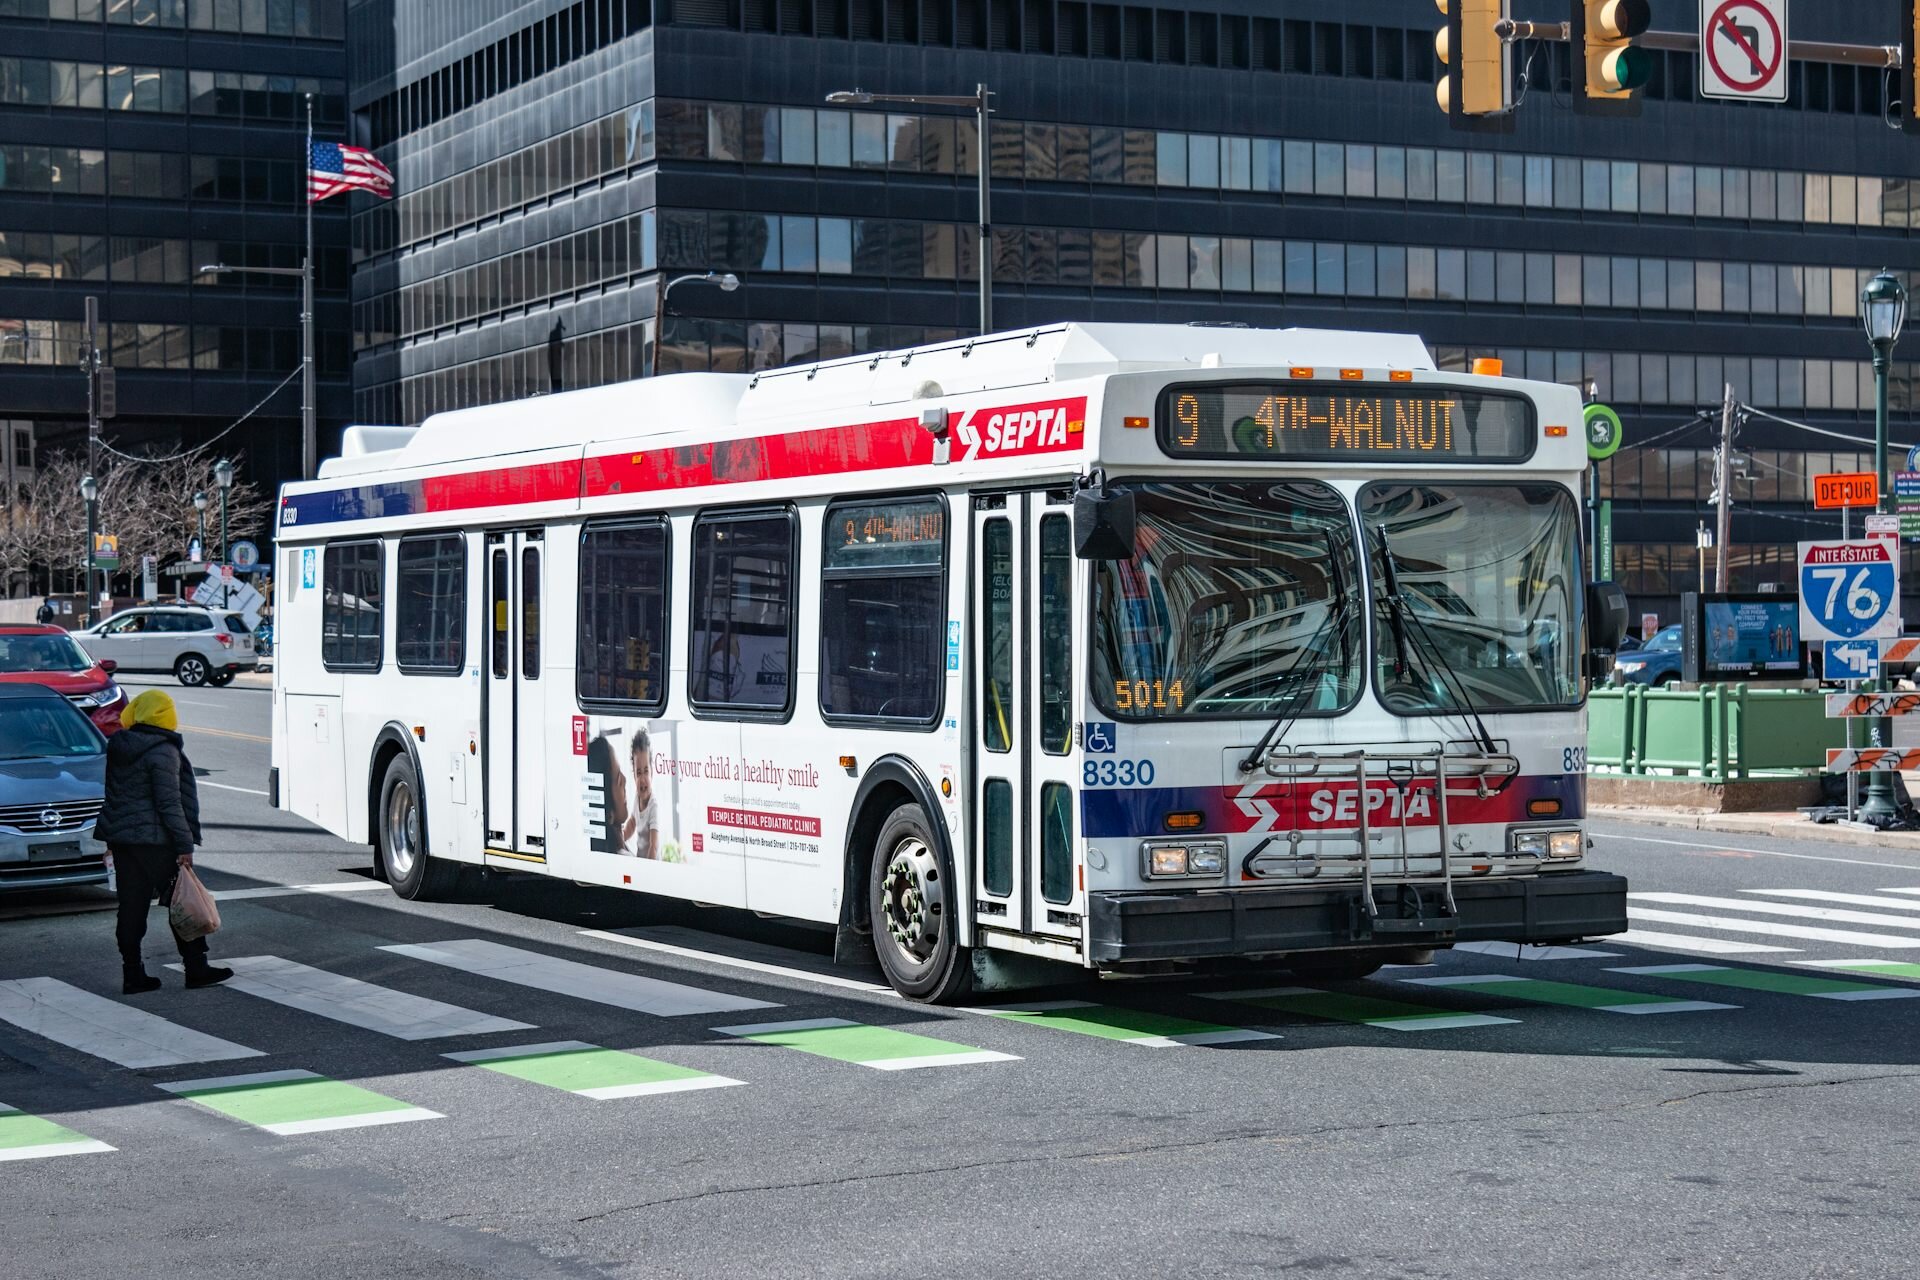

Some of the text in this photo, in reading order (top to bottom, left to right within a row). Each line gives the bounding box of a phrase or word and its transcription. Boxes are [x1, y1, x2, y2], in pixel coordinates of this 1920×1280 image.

[985, 407, 1067, 452] SEPTA
[1177, 395, 1456, 450] 9 4TH-WALNUT
[1592, 435, 1610, 443] SEPTA
[1821, 481, 1872, 500] DETOUR
[283, 507, 298, 524] 8330
[846, 520, 855, 545] 9
[1815, 548, 1880, 562] INTERSTATE
[1812, 567, 1881, 620] 76
[1116, 680, 1184, 708] 5014
[655, 752, 819, 791] Give your child a healthy smile
[1563, 746, 1588, 772] 833
[1083, 759, 1155, 786] 8330
[1308, 787, 1431, 822] SEPTA
[711, 810, 817, 833] TEMPLE DENTAL PEDIATRIC CLINIC
[711, 832, 730, 844] Allegheny
[730, 834, 745, 843] Avenue
[749, 836, 760, 845] North
[761, 838, 773, 846] Broad
[773, 839, 786, 848] Street
